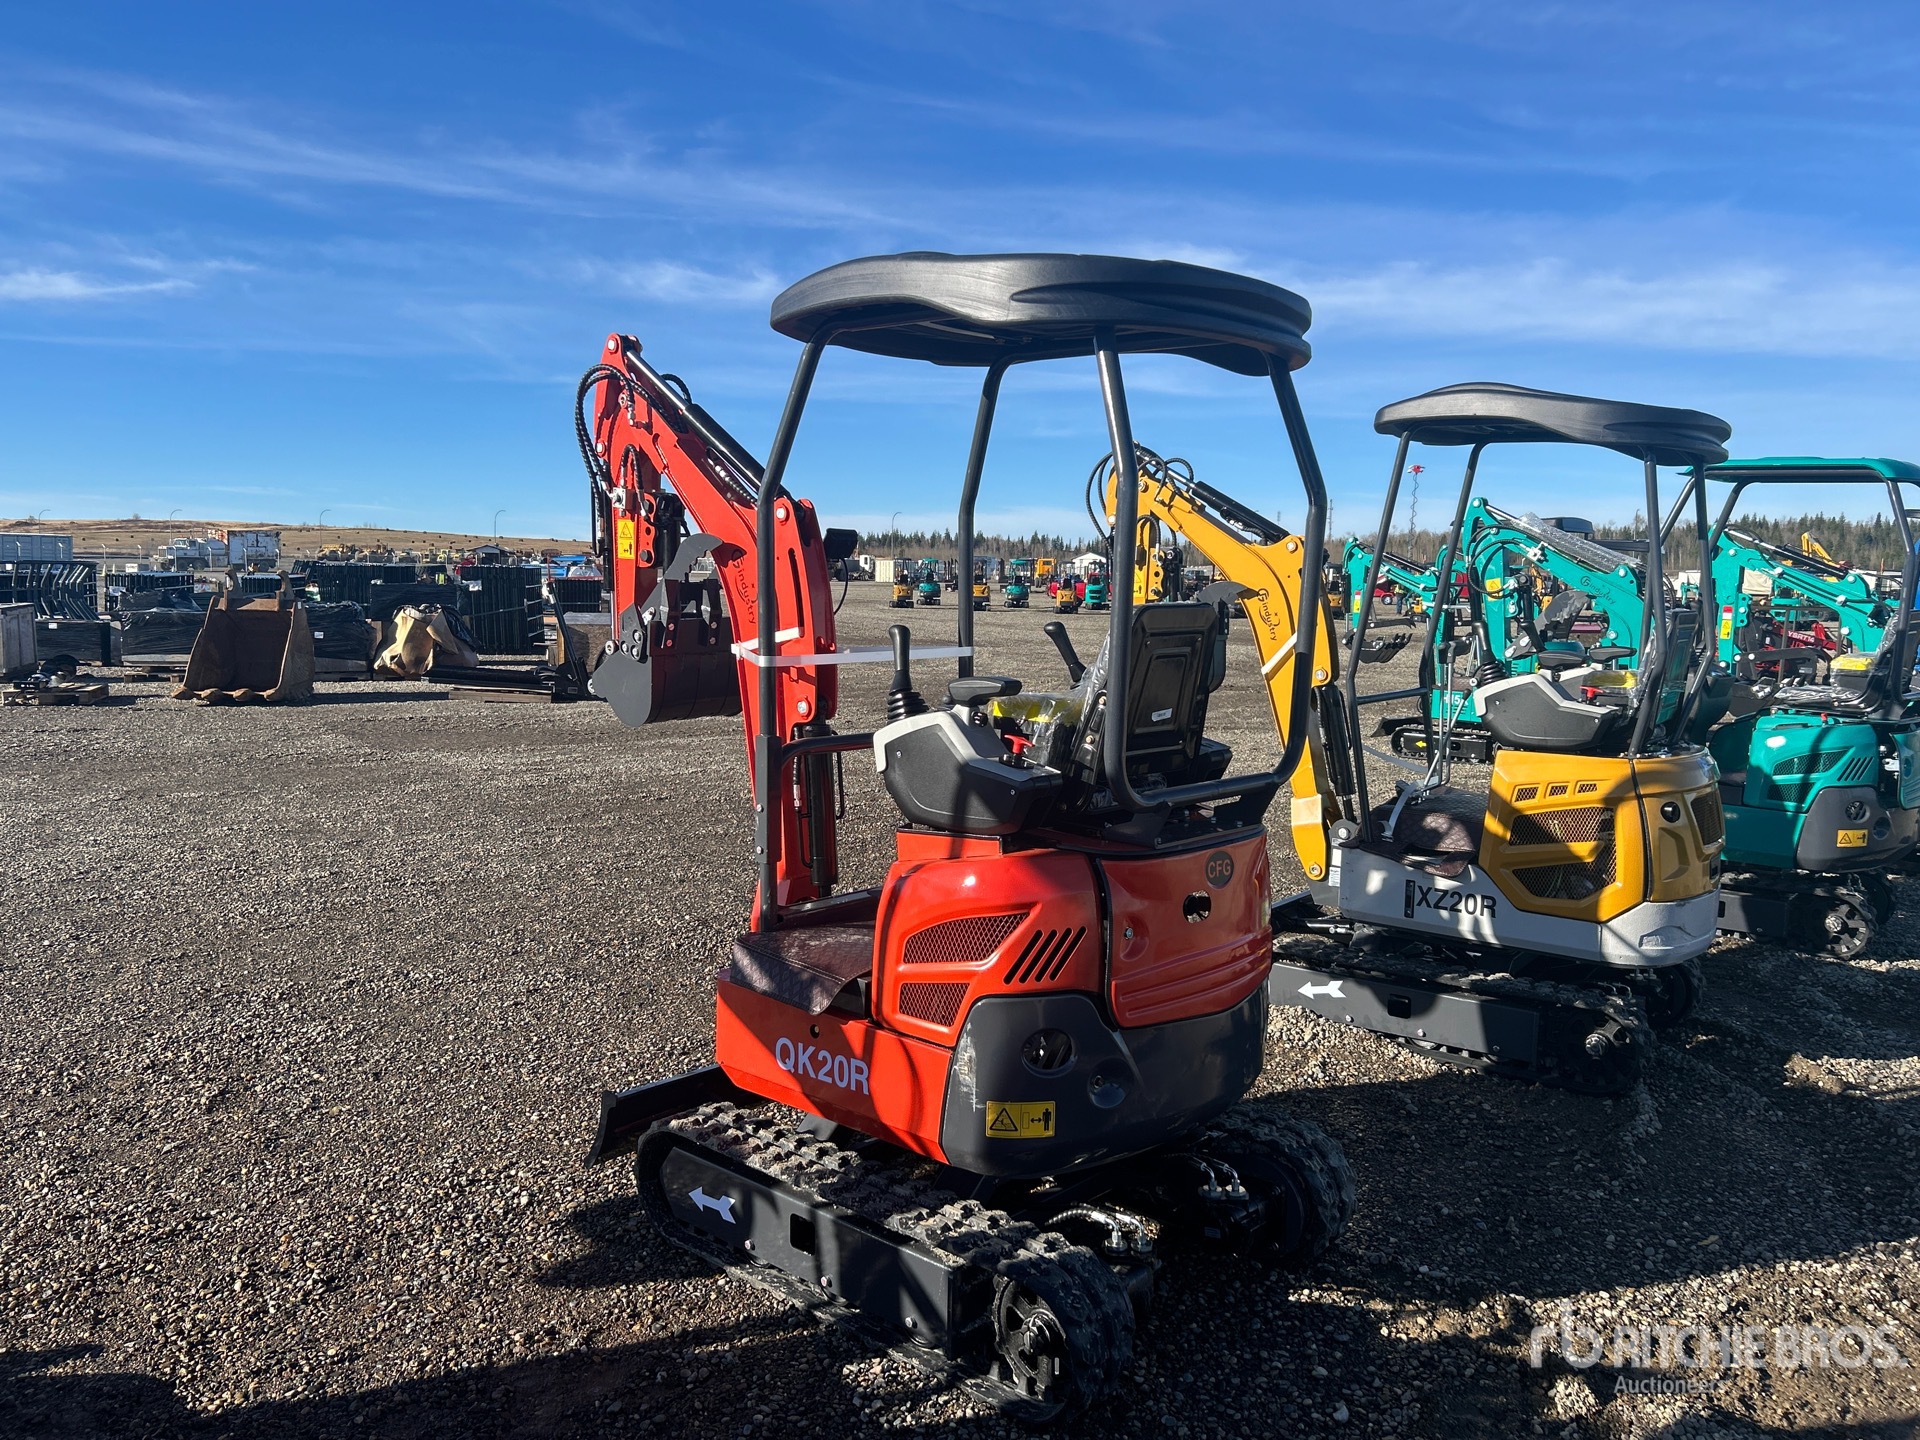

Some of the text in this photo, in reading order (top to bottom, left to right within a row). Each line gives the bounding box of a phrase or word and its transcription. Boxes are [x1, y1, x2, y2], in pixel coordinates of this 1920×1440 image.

[1208, 860, 1231, 878] CFG
[1416, 885, 1497, 918] XZ20R
[775, 1037, 869, 1095] QK20R
